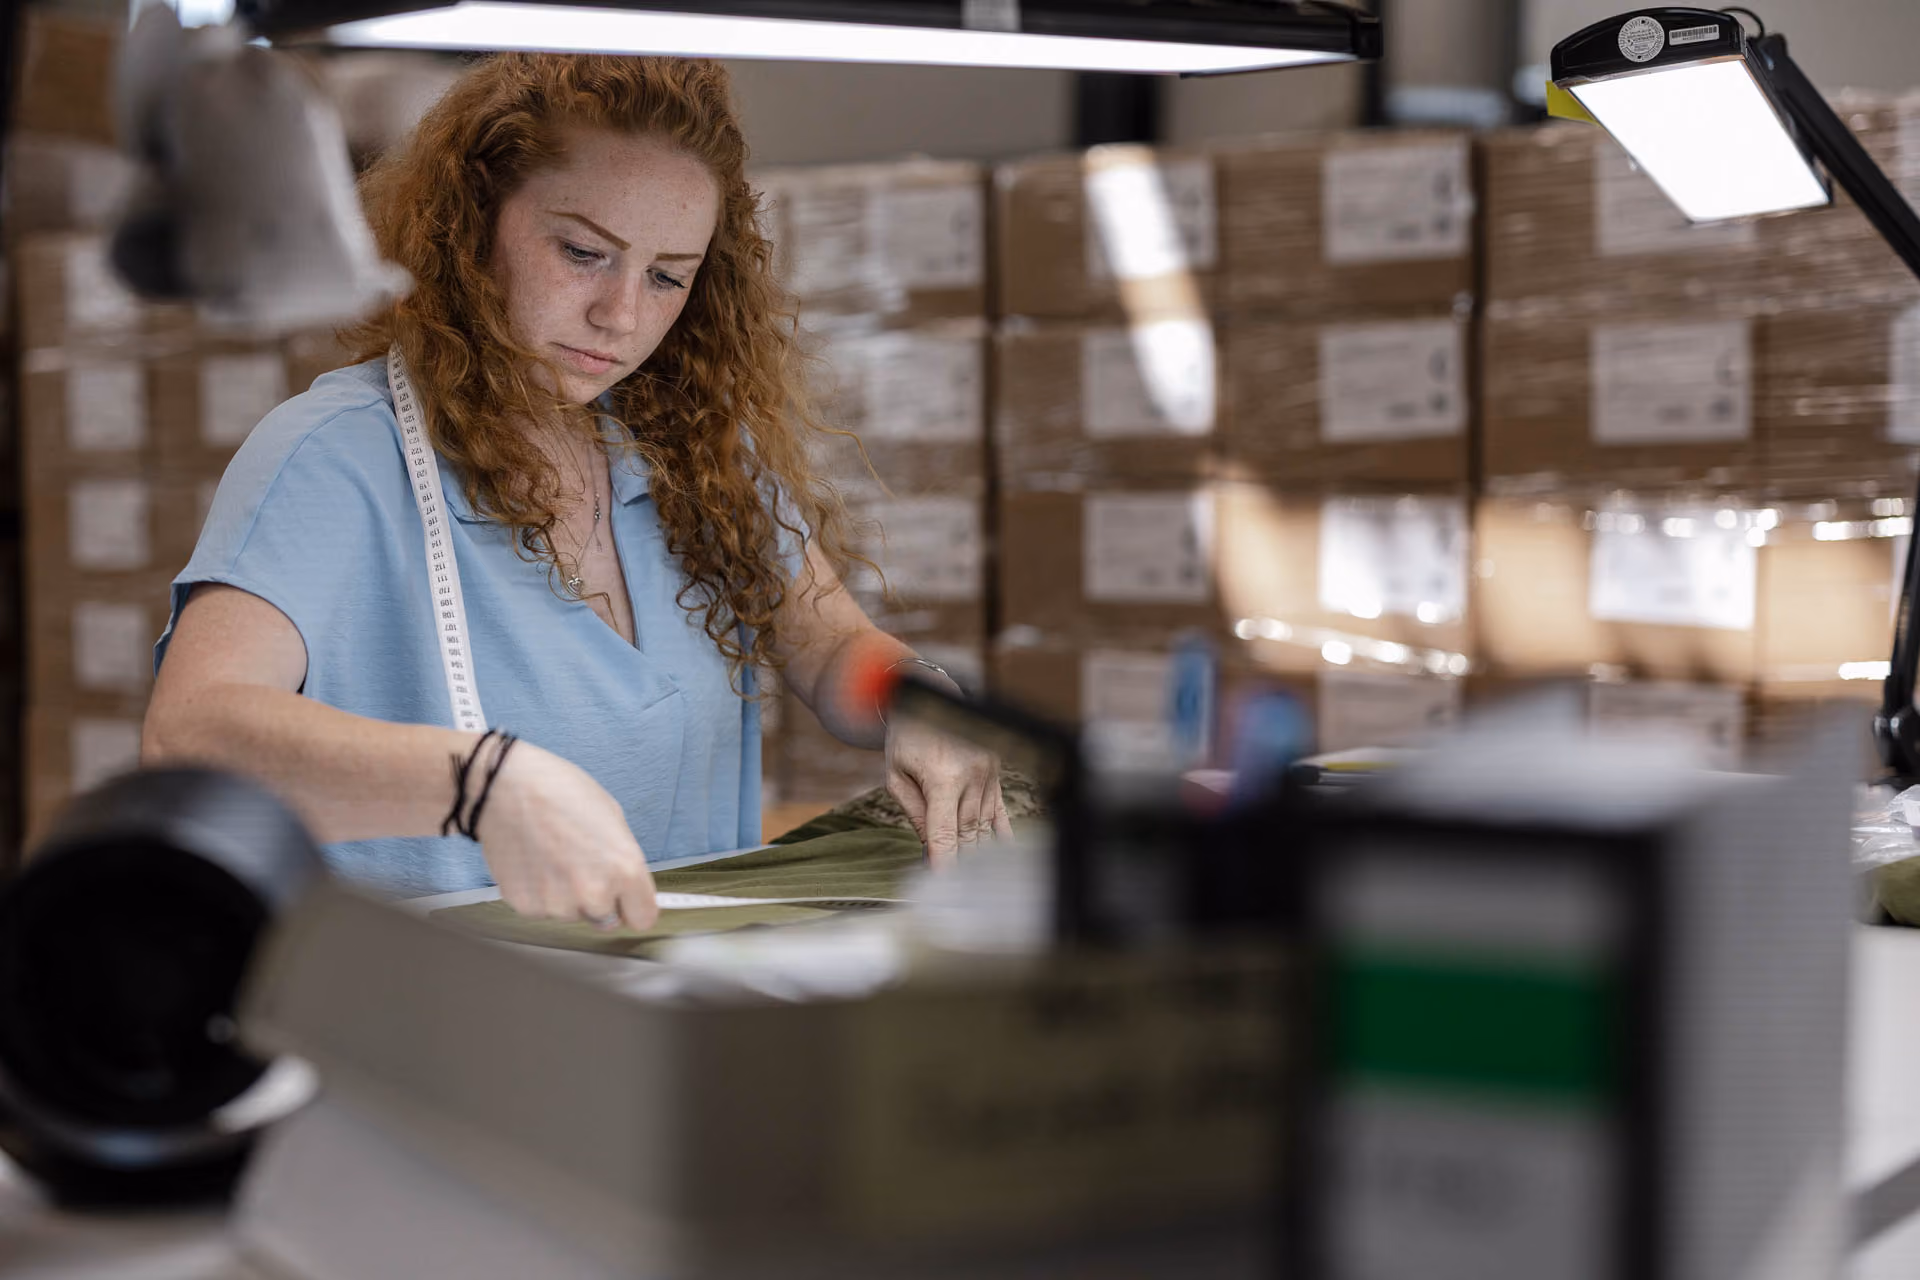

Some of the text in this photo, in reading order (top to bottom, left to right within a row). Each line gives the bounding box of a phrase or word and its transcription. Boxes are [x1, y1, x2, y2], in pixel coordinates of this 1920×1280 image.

[406, 426, 418, 434] 124
[414, 458, 425, 466] 121
[426, 504, 436, 515] 117
[428, 516, 438, 526] 116
[431, 539, 442, 548] 114
[433, 551, 444, 560] 113
[434, 563, 446, 572] 112
[437, 575, 448, 583] 111
[440, 599, 453, 607] 109
[442, 611, 455, 619] 108
[445, 623, 457, 632] 107
